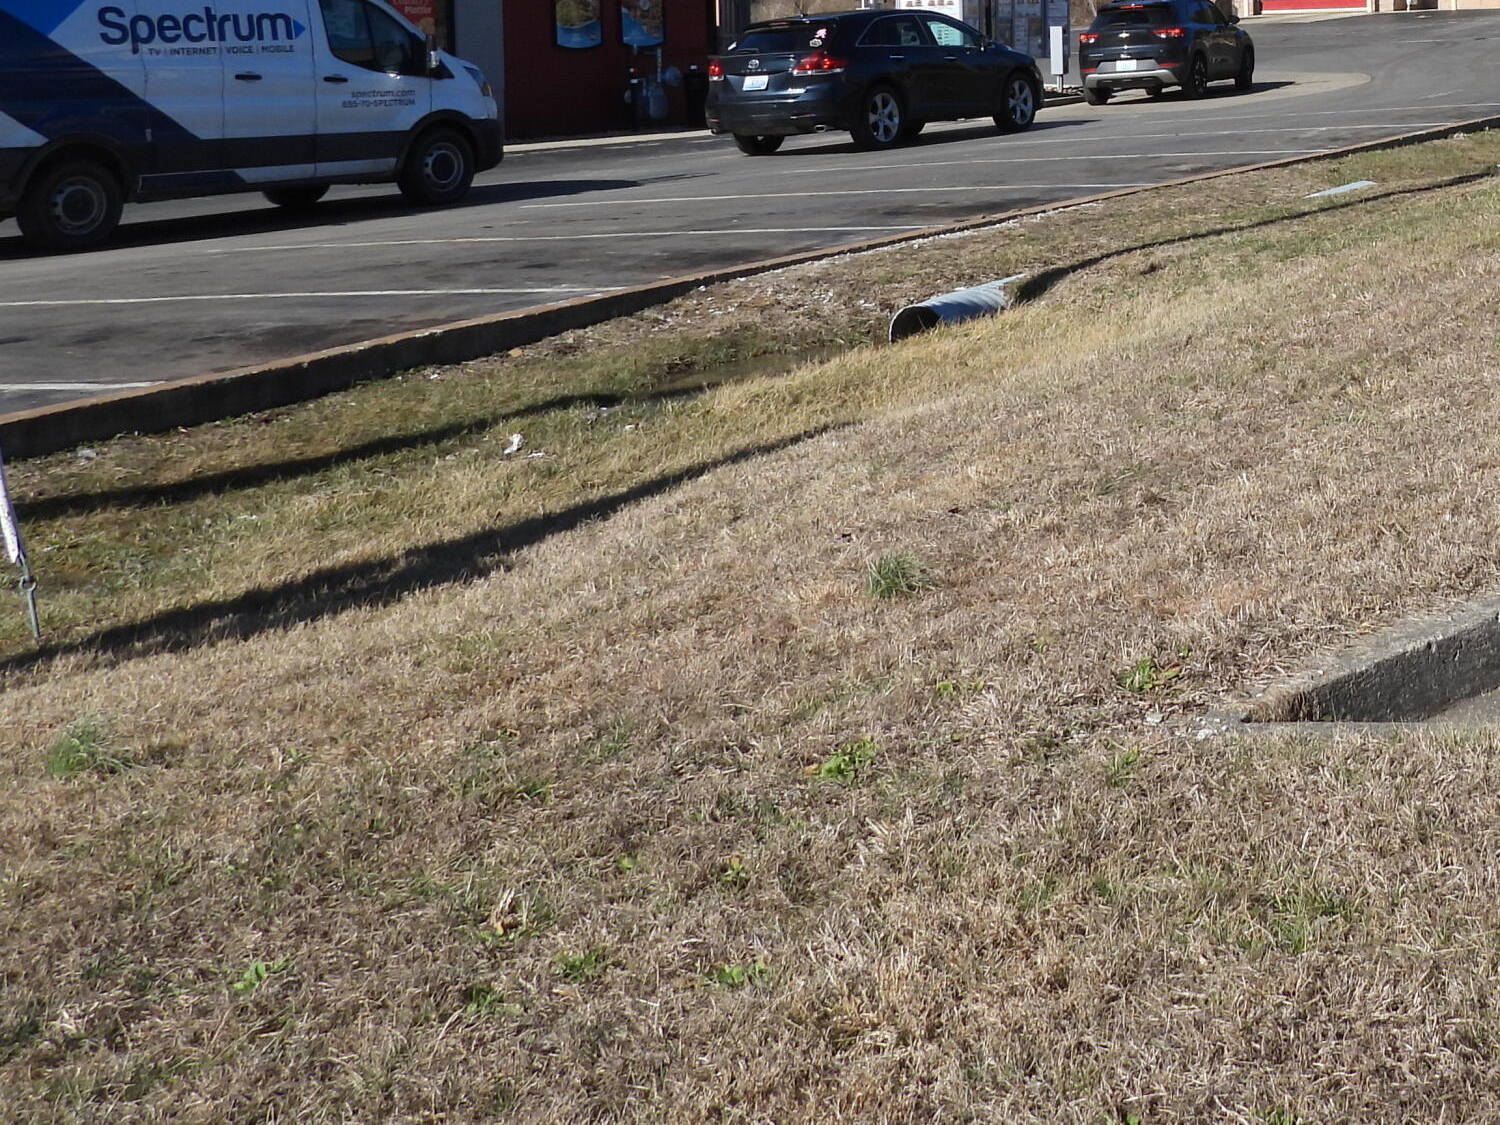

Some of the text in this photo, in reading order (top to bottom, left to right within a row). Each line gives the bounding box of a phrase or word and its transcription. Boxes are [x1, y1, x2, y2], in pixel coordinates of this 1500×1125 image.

[98, 6, 294, 55] Spectrum
[148, 44, 295, 56] TV INTERNET VOICE MOBILE
[351, 89, 416, 100] spectrum.com
